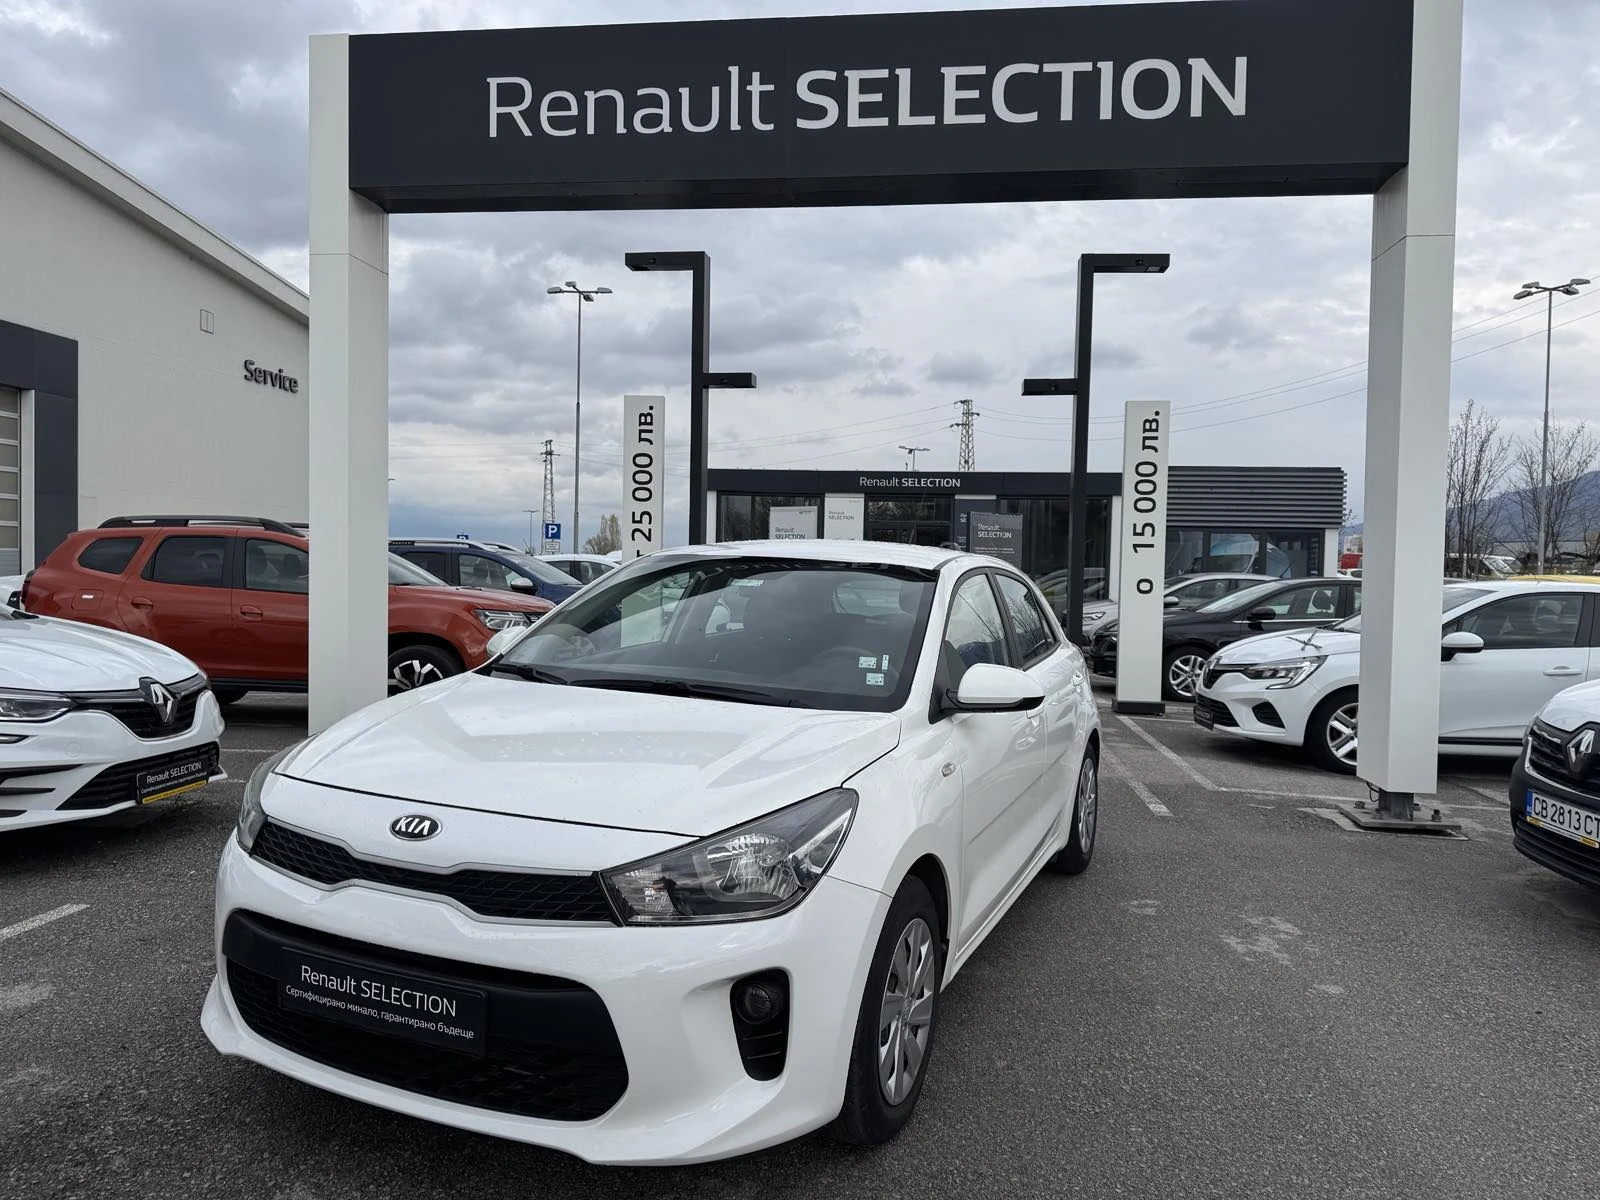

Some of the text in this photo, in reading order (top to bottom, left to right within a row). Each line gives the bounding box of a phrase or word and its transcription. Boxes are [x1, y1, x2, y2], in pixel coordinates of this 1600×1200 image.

[486, 56, 1248, 138] Renault SELECTION
[243, 359, 299, 394] Service
[638, 405, 654, 446] лв.
[1141, 410, 1160, 453] лв.
[631, 452, 654, 503] 000
[859, 476, 961, 488] Renault SELECTION
[1133, 460, 1158, 514] 000
[548, 525, 558, 538] P
[631, 510, 653, 542] 25
[977, 530, 1012, 538] SELECTION
[1132, 522, 1156, 554] 15
[146, 771, 169, 785] Renault
[170, 761, 202, 778] SELECTION
[394, 816, 431, 836] KIA
[1550, 803, 1581, 831] 2813
[301, 964, 457, 1017] Renault SELECTION
[286, 984, 475, 1040] Сертифицирано минало, гарантирано бъдеще
